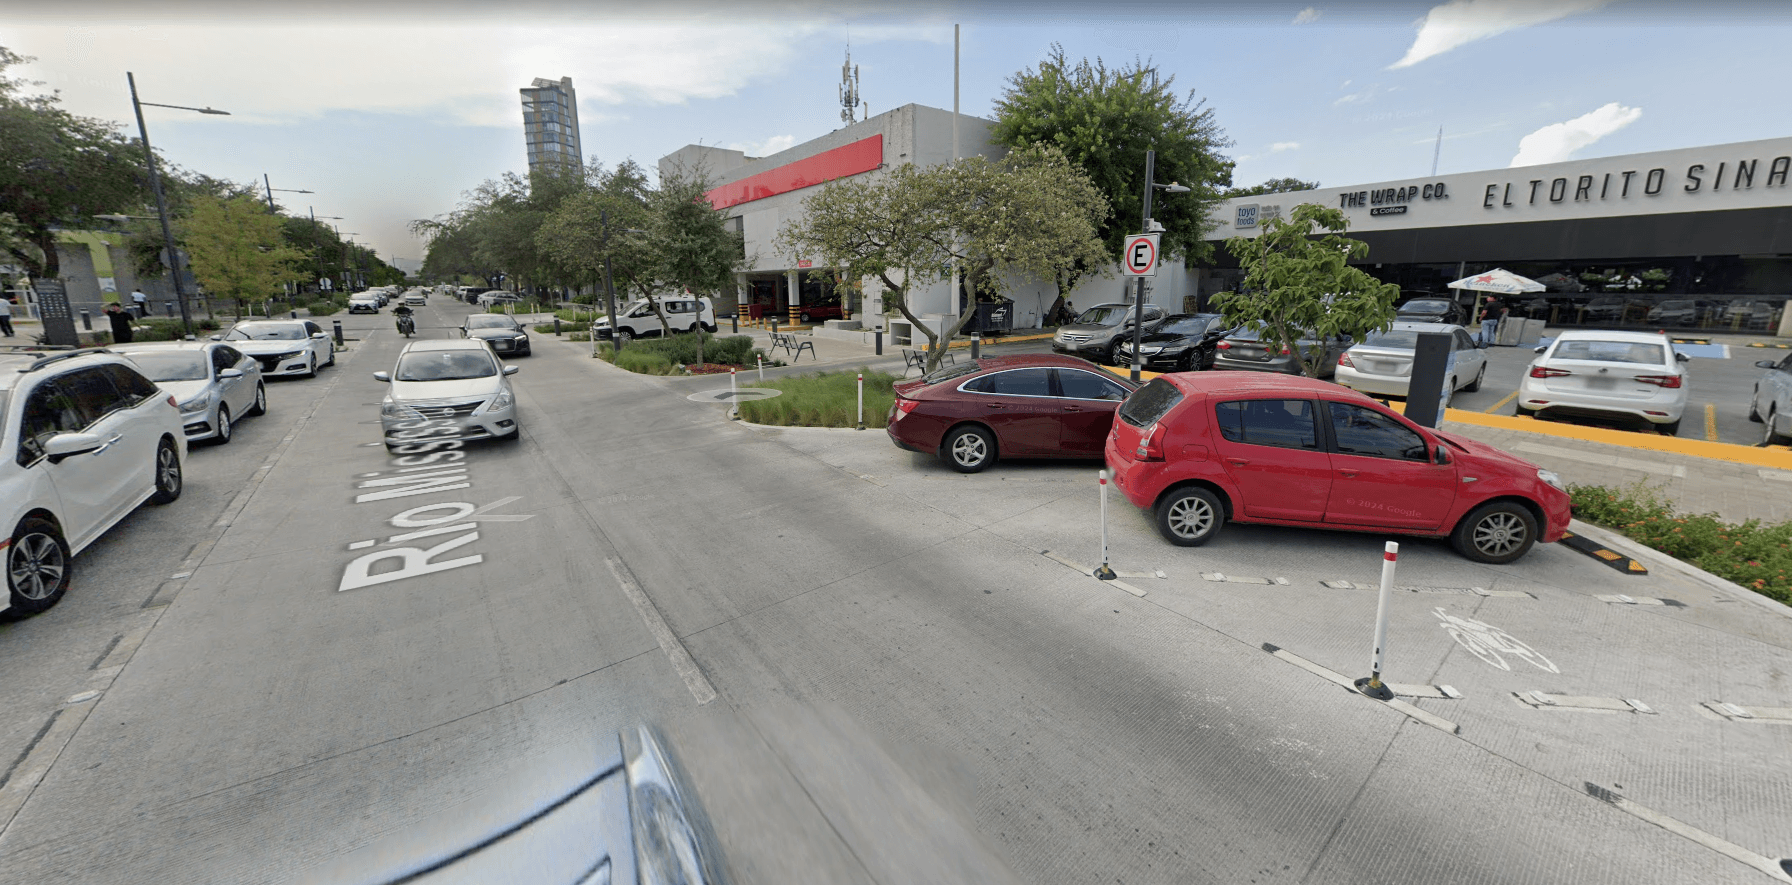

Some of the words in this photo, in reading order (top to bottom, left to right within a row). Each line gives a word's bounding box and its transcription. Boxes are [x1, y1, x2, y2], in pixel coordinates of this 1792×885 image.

[1483, 182, 1512, 208] EL
[1529, 168, 1665, 204] TORITO
[1684, 156, 1792, 193] SINA
[1340, 191, 1367, 209] THE
[1371, 186, 1418, 205] WRAP
[1422, 183, 1449, 200] CO.
[1238, 207, 1256, 217] toyo
[1380, 206, 1404, 214] Coffee
[1237, 217, 1255, 226] foods
[1134, 244, 1148, 267] E
